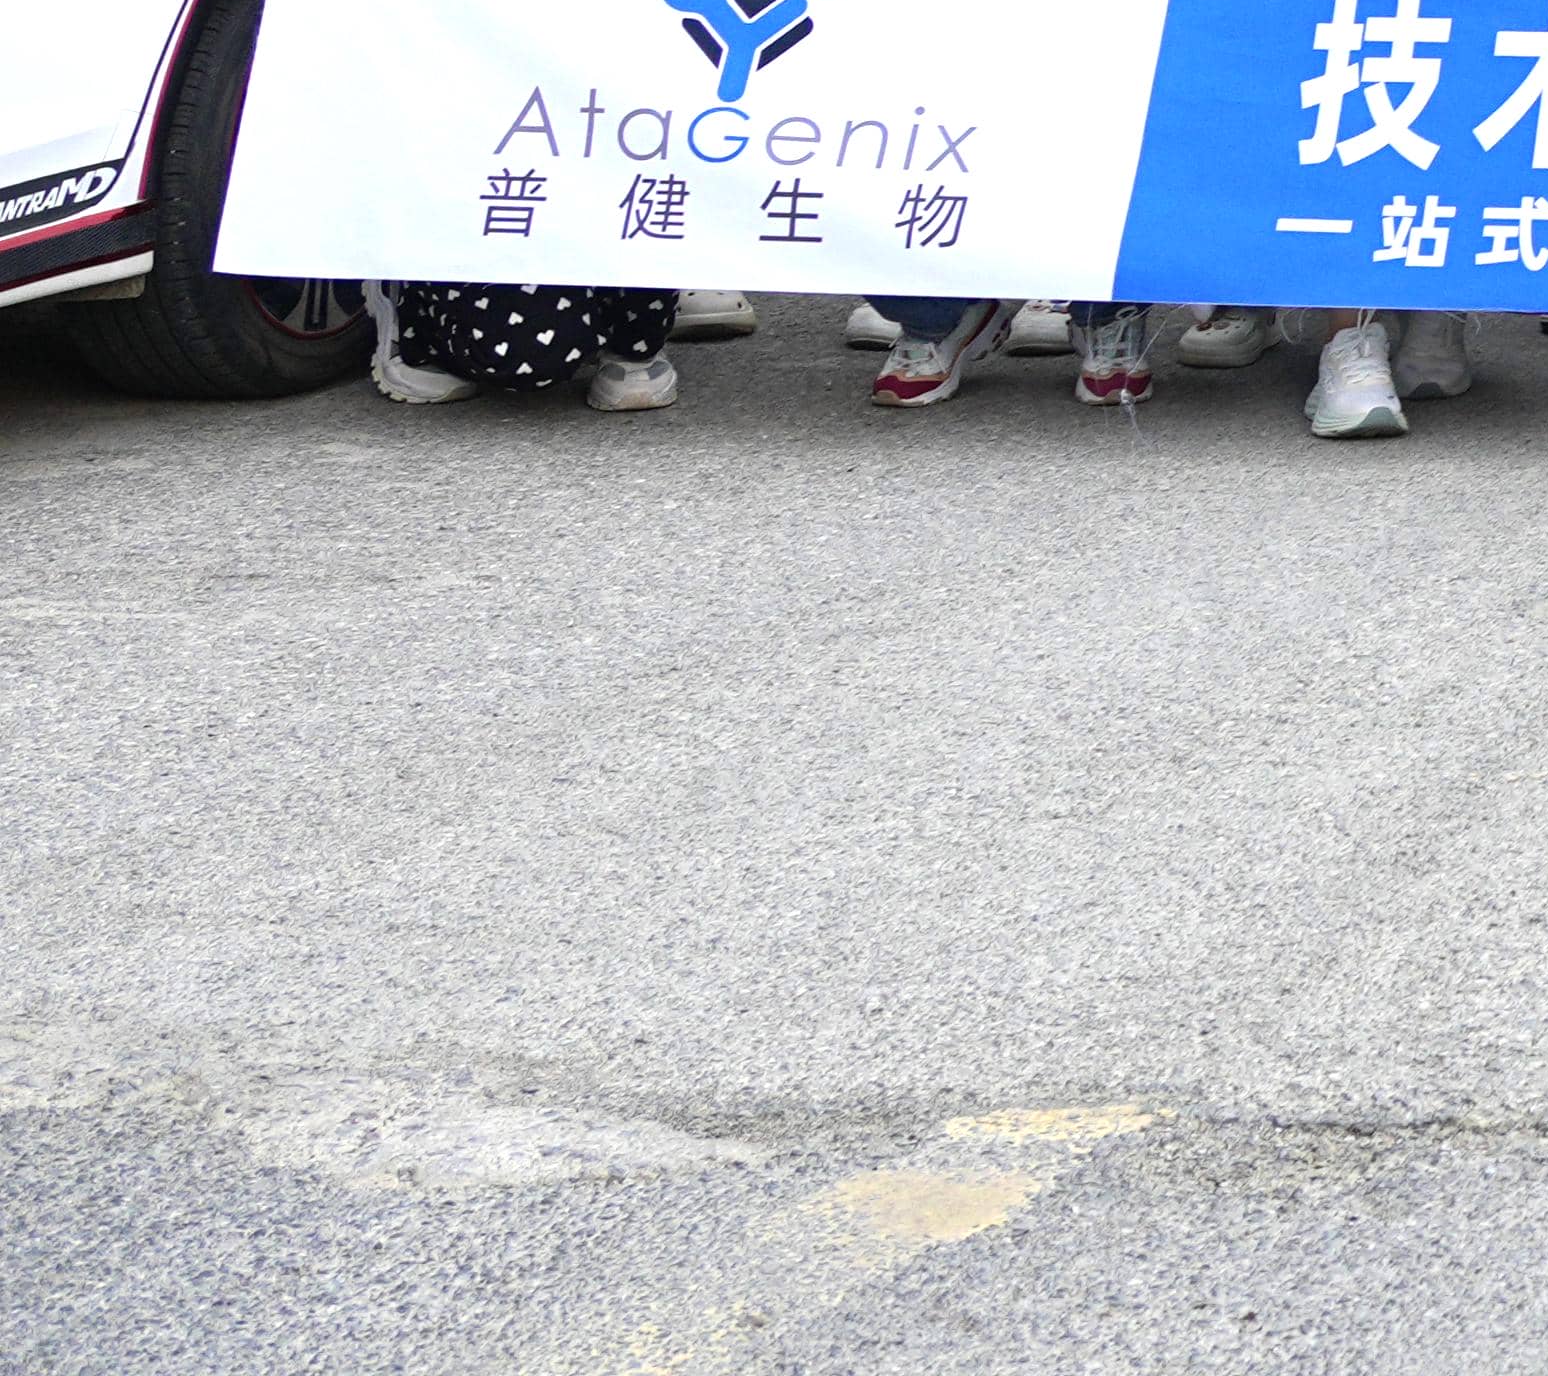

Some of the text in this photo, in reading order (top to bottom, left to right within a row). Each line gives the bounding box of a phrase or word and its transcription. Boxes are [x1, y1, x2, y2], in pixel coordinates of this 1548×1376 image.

[493, 86, 978, 174] AtaGenix
[480, 166, 968, 250] 普健生物
